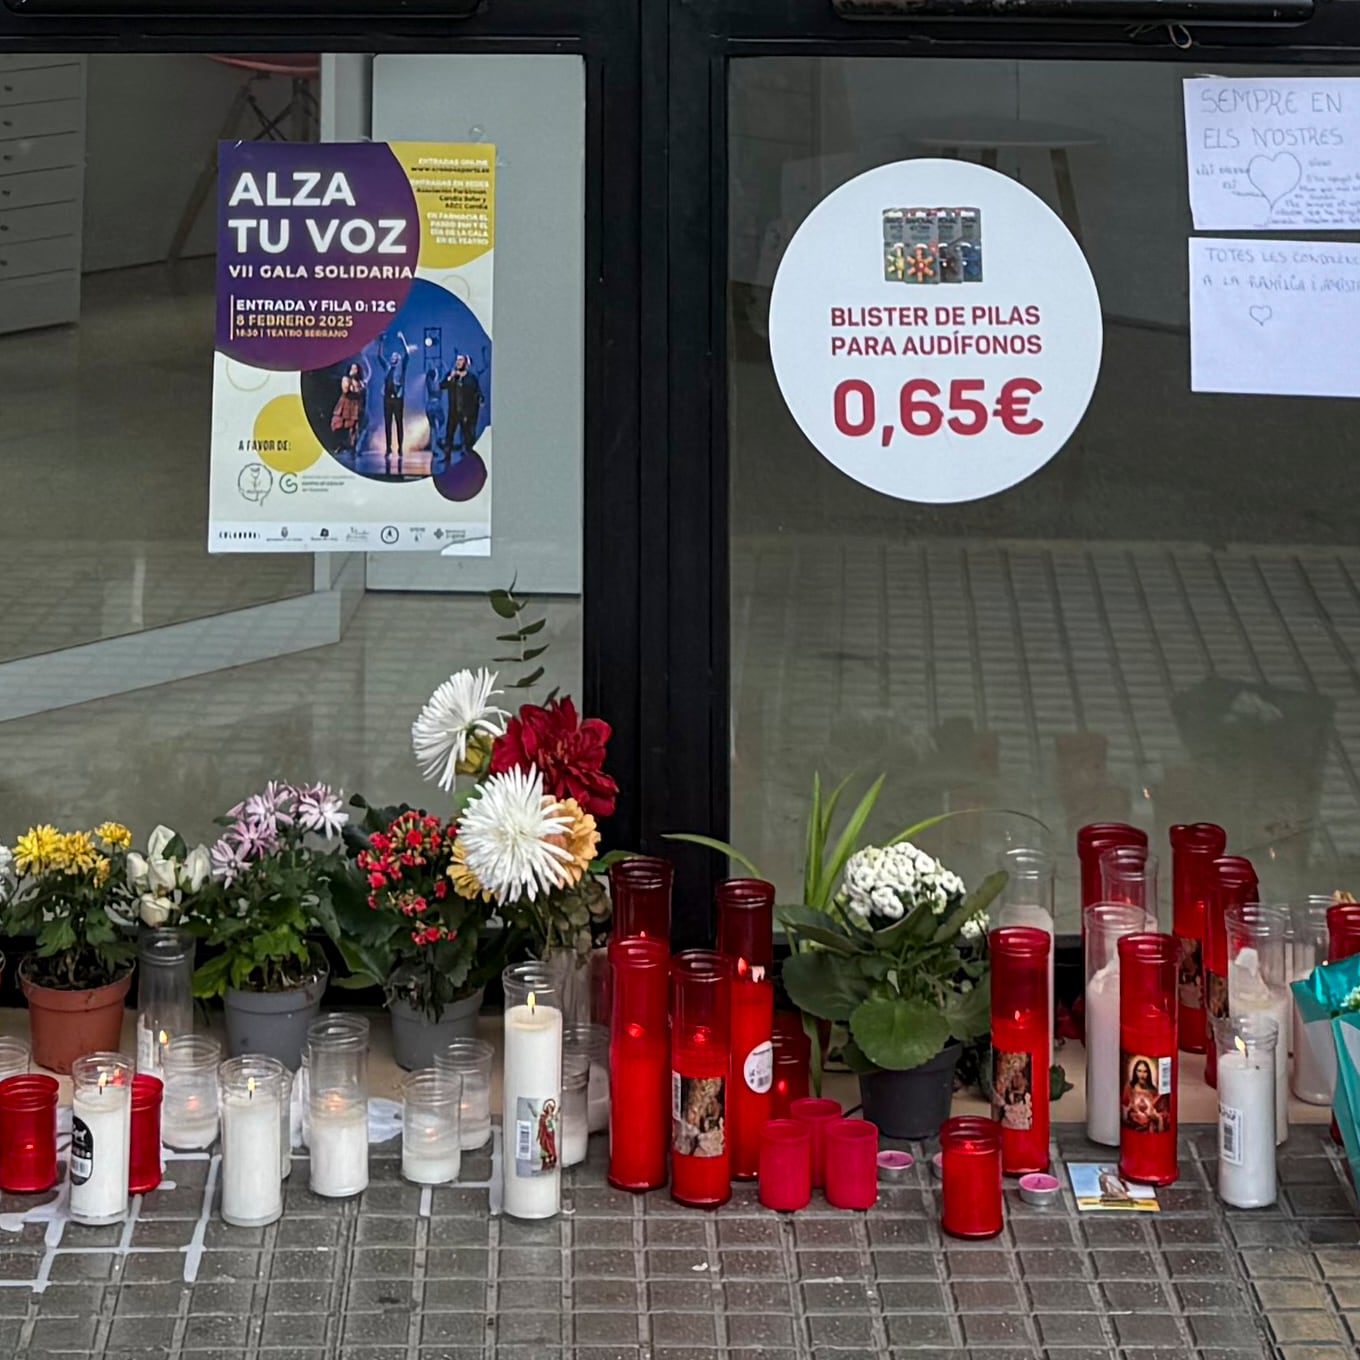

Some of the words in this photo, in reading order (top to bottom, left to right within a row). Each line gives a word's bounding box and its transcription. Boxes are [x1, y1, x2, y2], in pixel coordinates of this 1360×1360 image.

[1201, 89, 1297, 115] SEMPRE
[1312, 92, 1341, 113] EN
[1204, 128, 1240, 149] ELS
[1252, 127, 1343, 148] NOSTRES
[228, 172, 356, 206] ALZA
[228, 219, 289, 253] TU
[305, 219, 407, 254] VOZ
[229, 265, 253, 278] VII
[260, 265, 308, 279] GALA
[314, 266, 413, 280] SOLIDARIA
[236, 299, 305, 312] ENTRADA
[308, 300, 318, 312] Y
[321, 300, 352, 312] FILA
[831, 306, 928, 327] BLISTER
[935, 307, 965, 326] DE
[972, 306, 1040, 325] PILAS
[249, 315, 315, 327] FEBRERO
[319, 315, 353, 327] 2025
[831, 336, 896, 356] PARA
[902, 330, 1042, 356] AUDÍFONOS
[834, 377, 1044, 447] 0,65€
